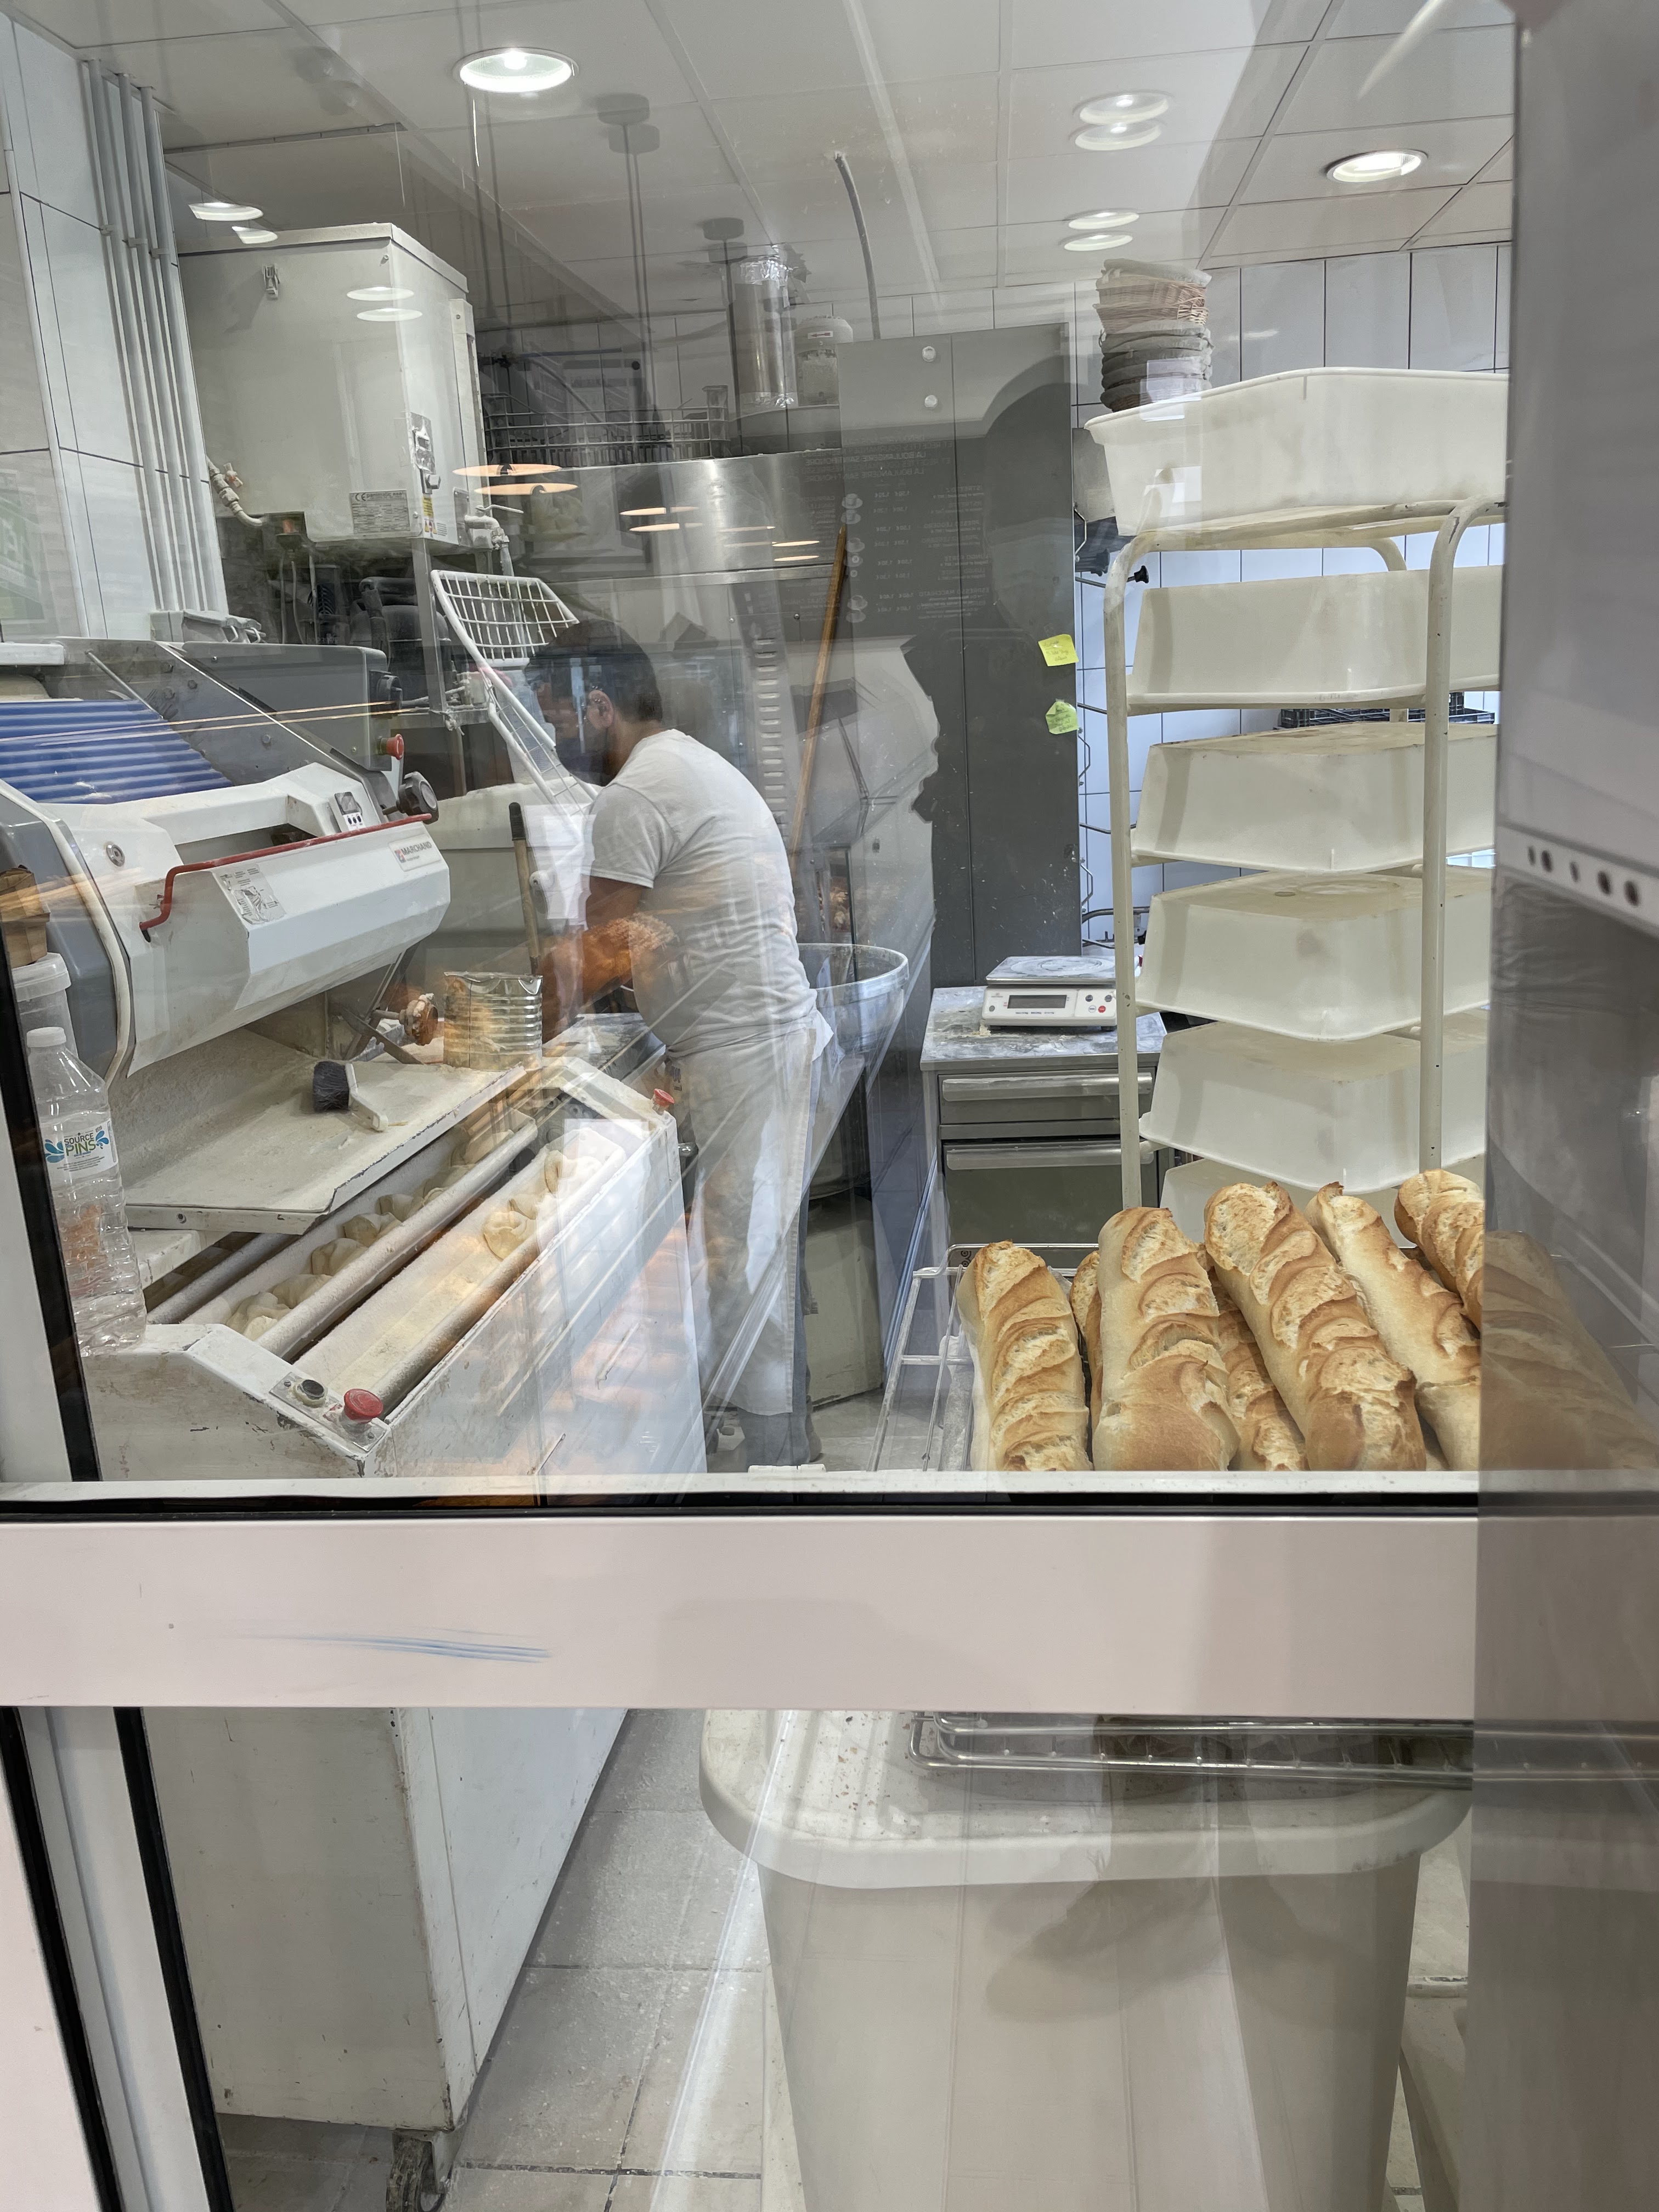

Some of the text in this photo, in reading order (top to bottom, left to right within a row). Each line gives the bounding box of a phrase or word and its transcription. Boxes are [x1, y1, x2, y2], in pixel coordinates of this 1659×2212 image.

[401, 841, 432, 855] MARCHAND
[64, 1132, 94, 1146] SOURCE
[66, 1139, 96, 1156] PINS
